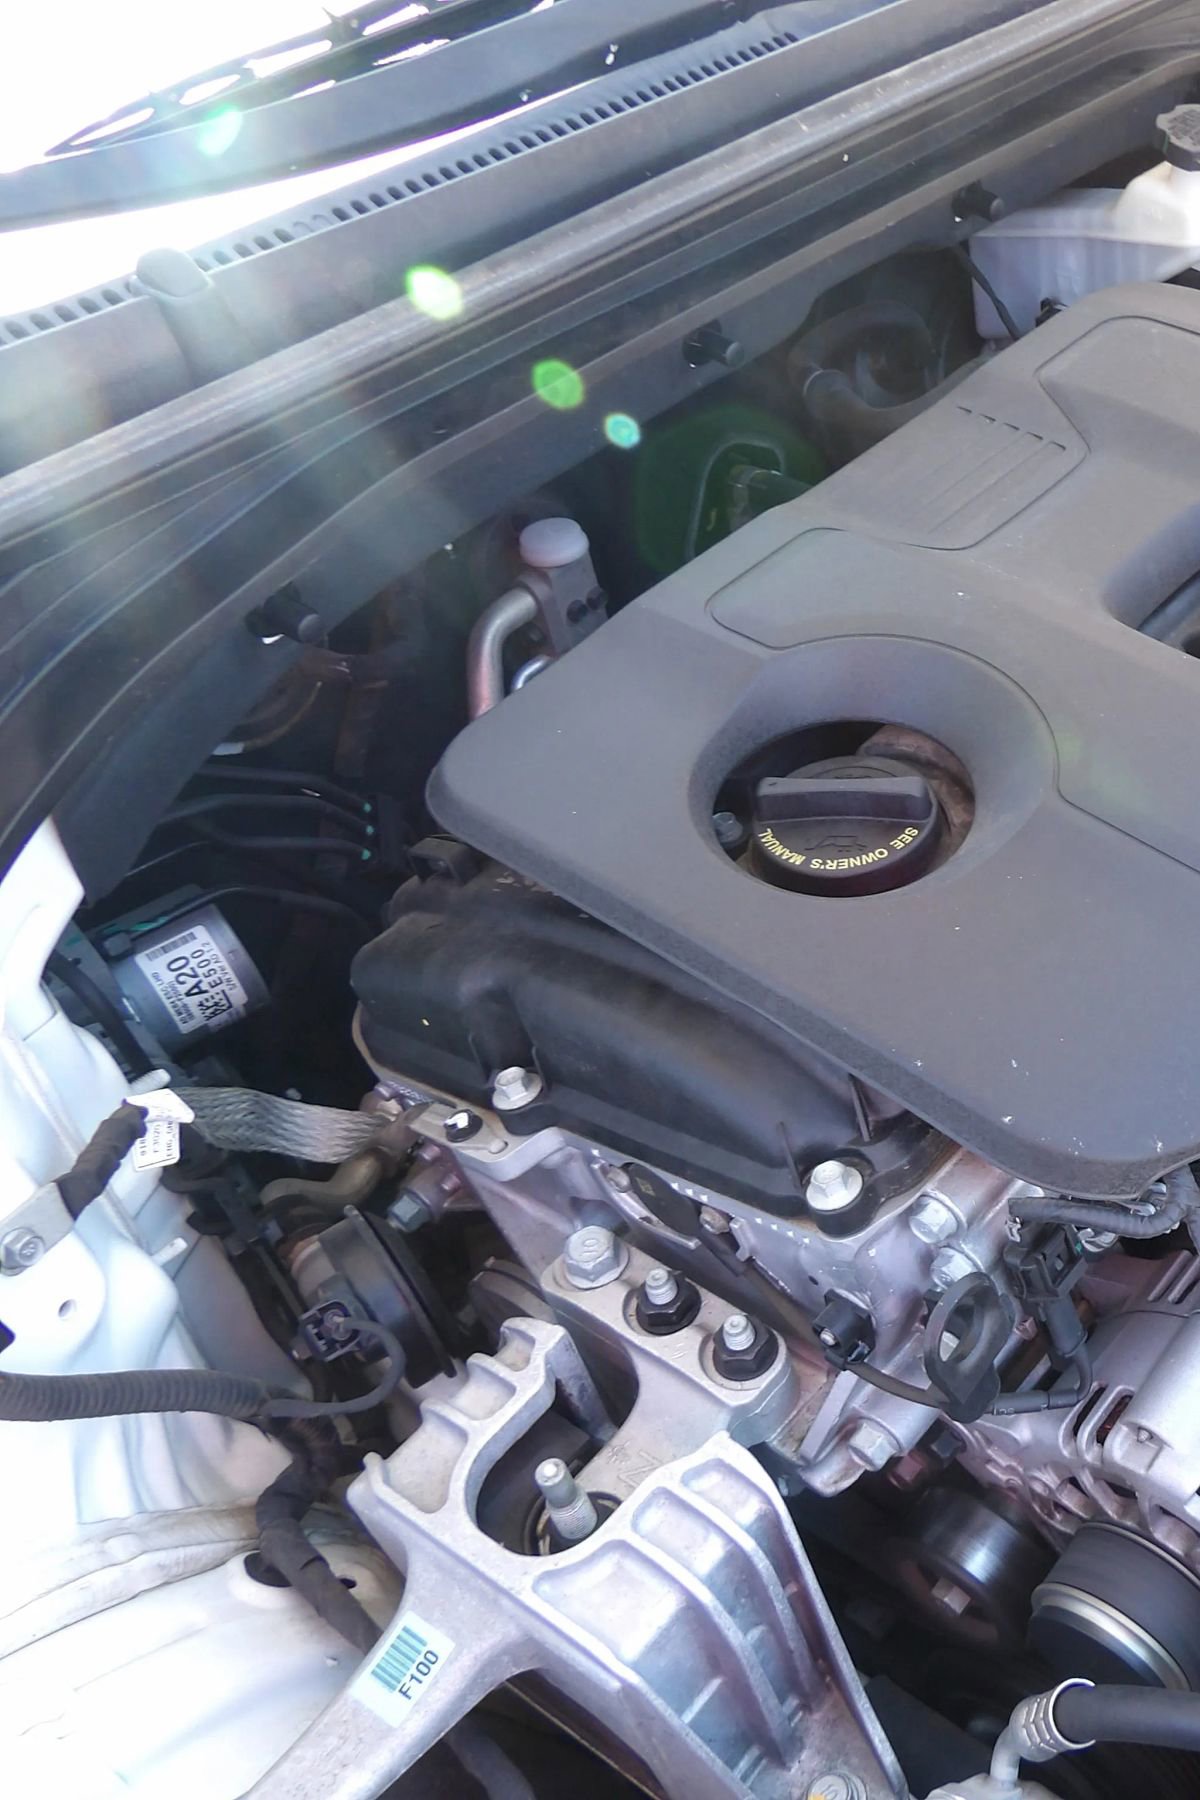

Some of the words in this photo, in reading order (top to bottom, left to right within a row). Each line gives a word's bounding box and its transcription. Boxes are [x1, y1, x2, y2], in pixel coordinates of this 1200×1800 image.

[757, 827, 807, 866] MANUAL
[889, 826, 919, 850] SEE
[810, 848, 889, 871] OWNER'S
[167, 955, 208, 998] A20
[191, 949, 223, 993] E500
[398, 1649, 439, 1700] F100
